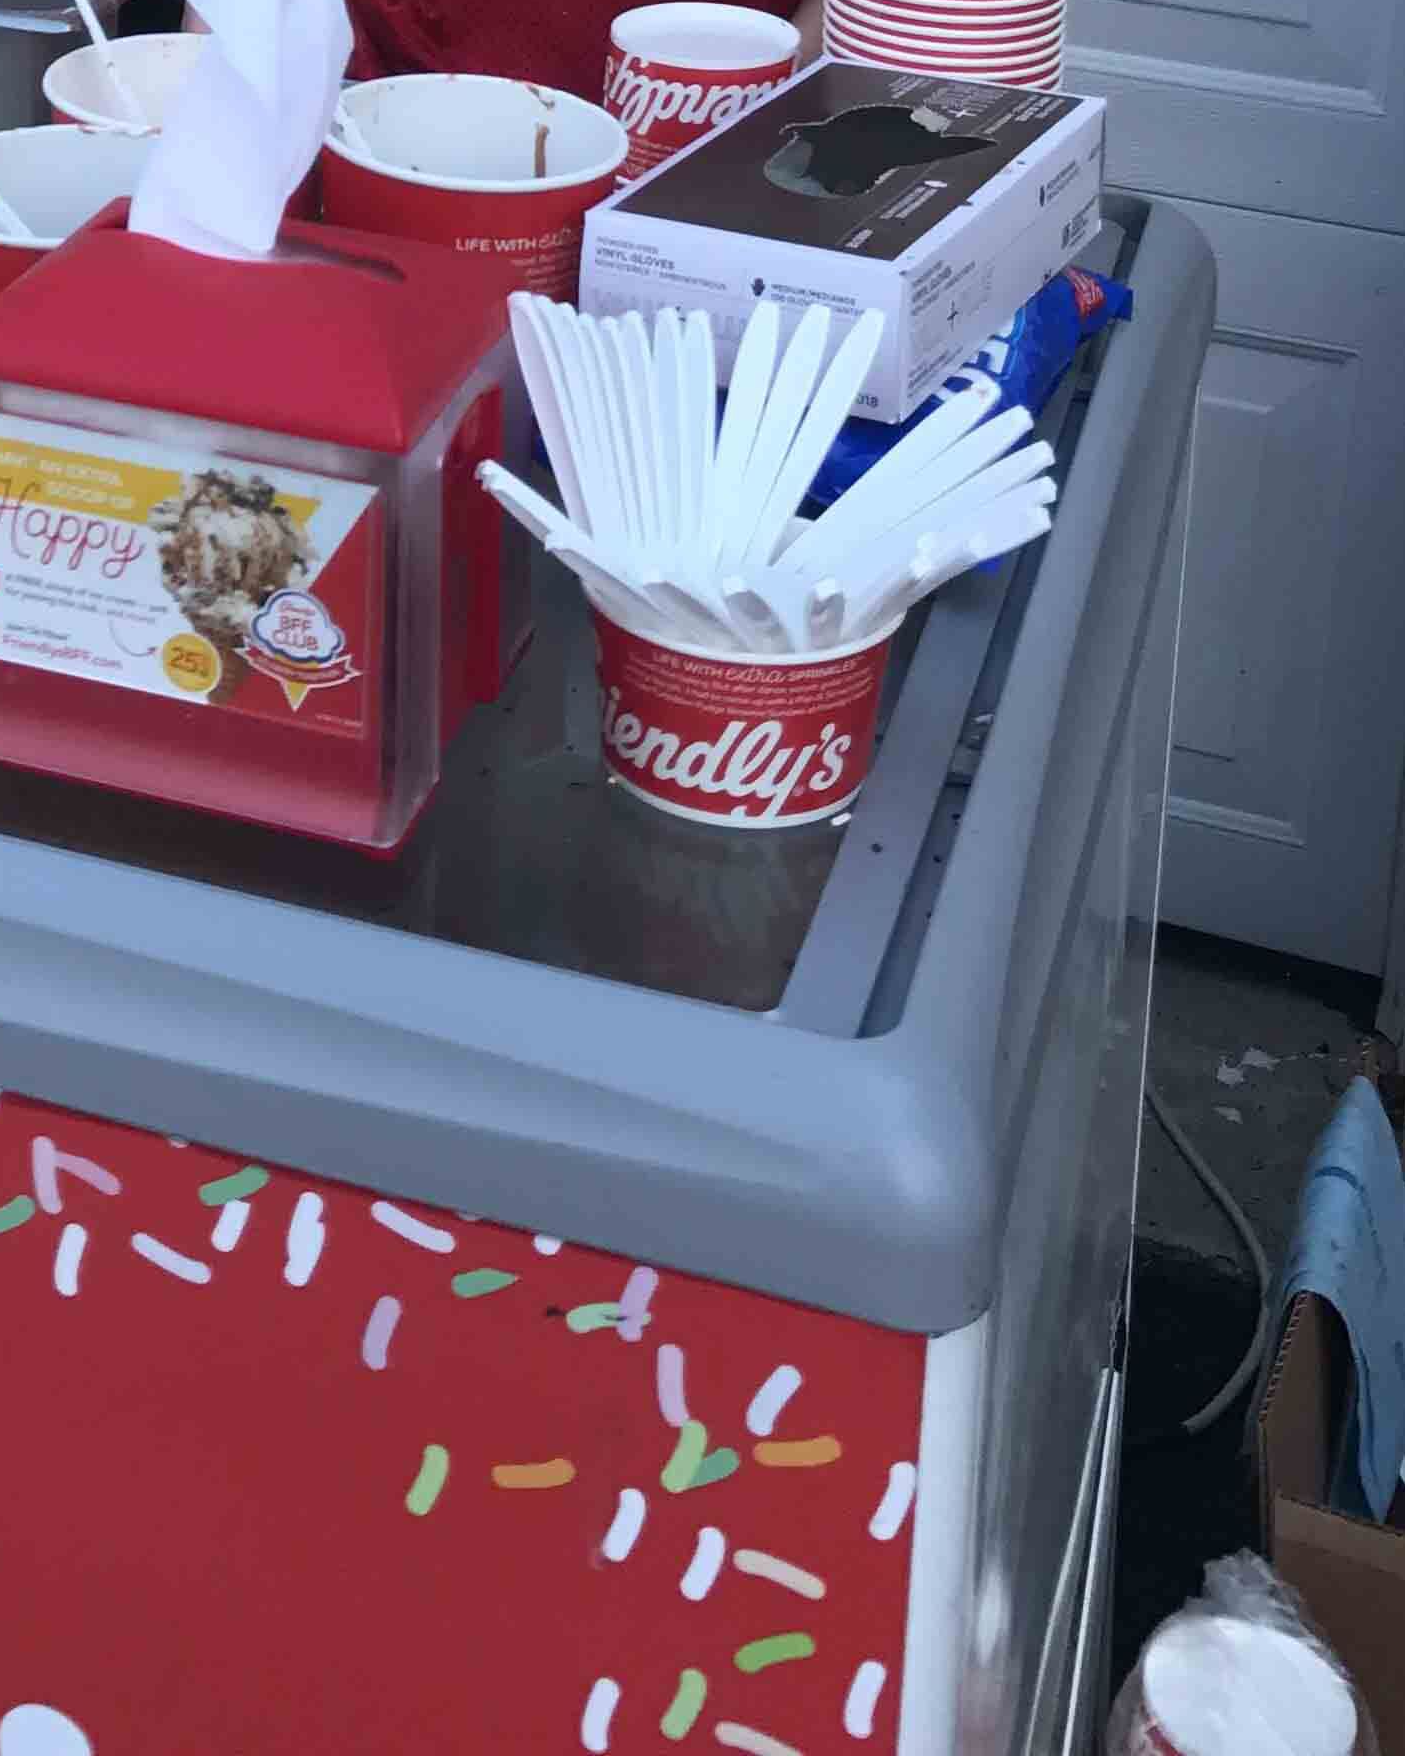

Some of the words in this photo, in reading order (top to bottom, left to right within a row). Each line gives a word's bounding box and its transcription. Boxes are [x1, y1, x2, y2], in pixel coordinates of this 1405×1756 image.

[455, 237, 492, 253] LIFE
[494, 237, 537, 253] WITH
[273, 627, 320, 651] CLUB
[682, 658, 723, 677] WITH
[603, 685, 852, 820] iendly's
